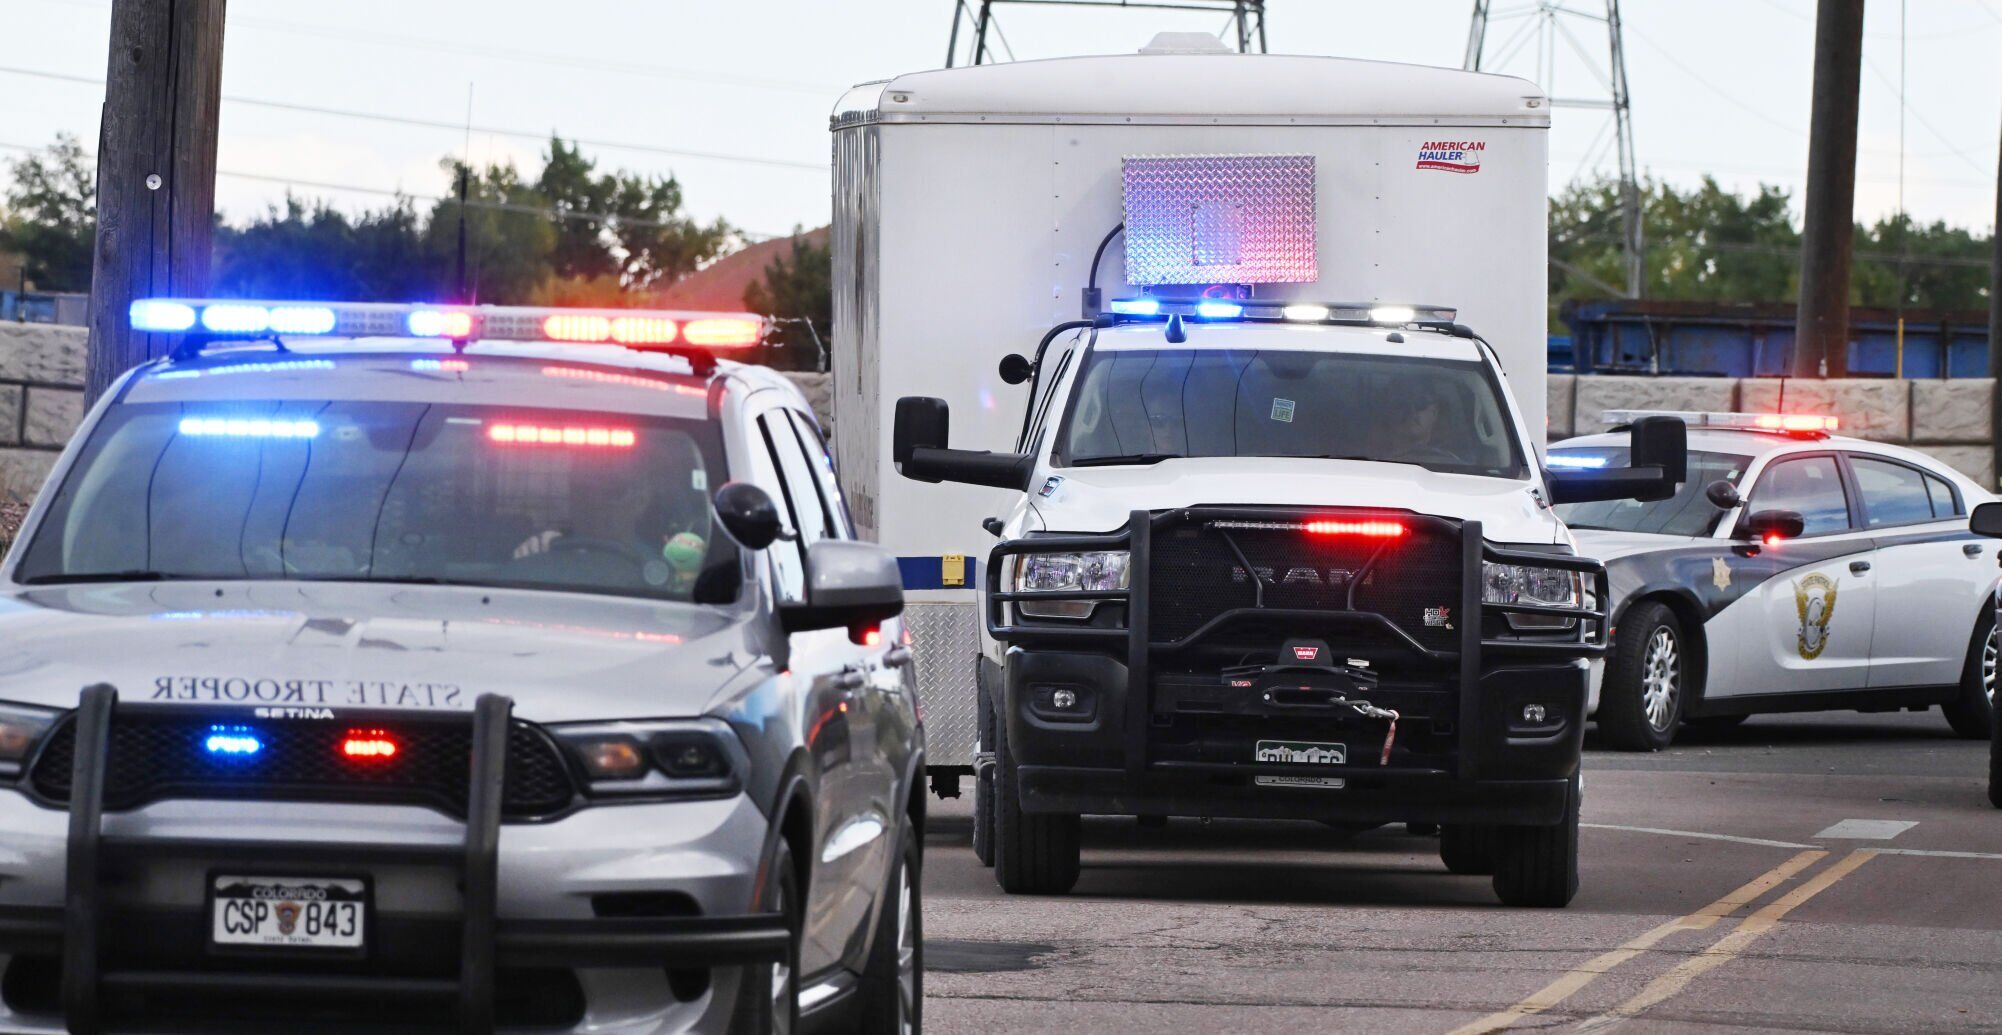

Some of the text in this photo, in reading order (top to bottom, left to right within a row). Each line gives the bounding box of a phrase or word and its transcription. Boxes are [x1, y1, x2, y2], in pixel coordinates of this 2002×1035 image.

[1421, 141, 1486, 151] AMERICAN
[1418, 151, 1463, 161] HAULER
[254, 707, 335, 720] SETINA
[252, 887, 327, 900] COLORADO
[223, 900, 357, 937] CSP 843
